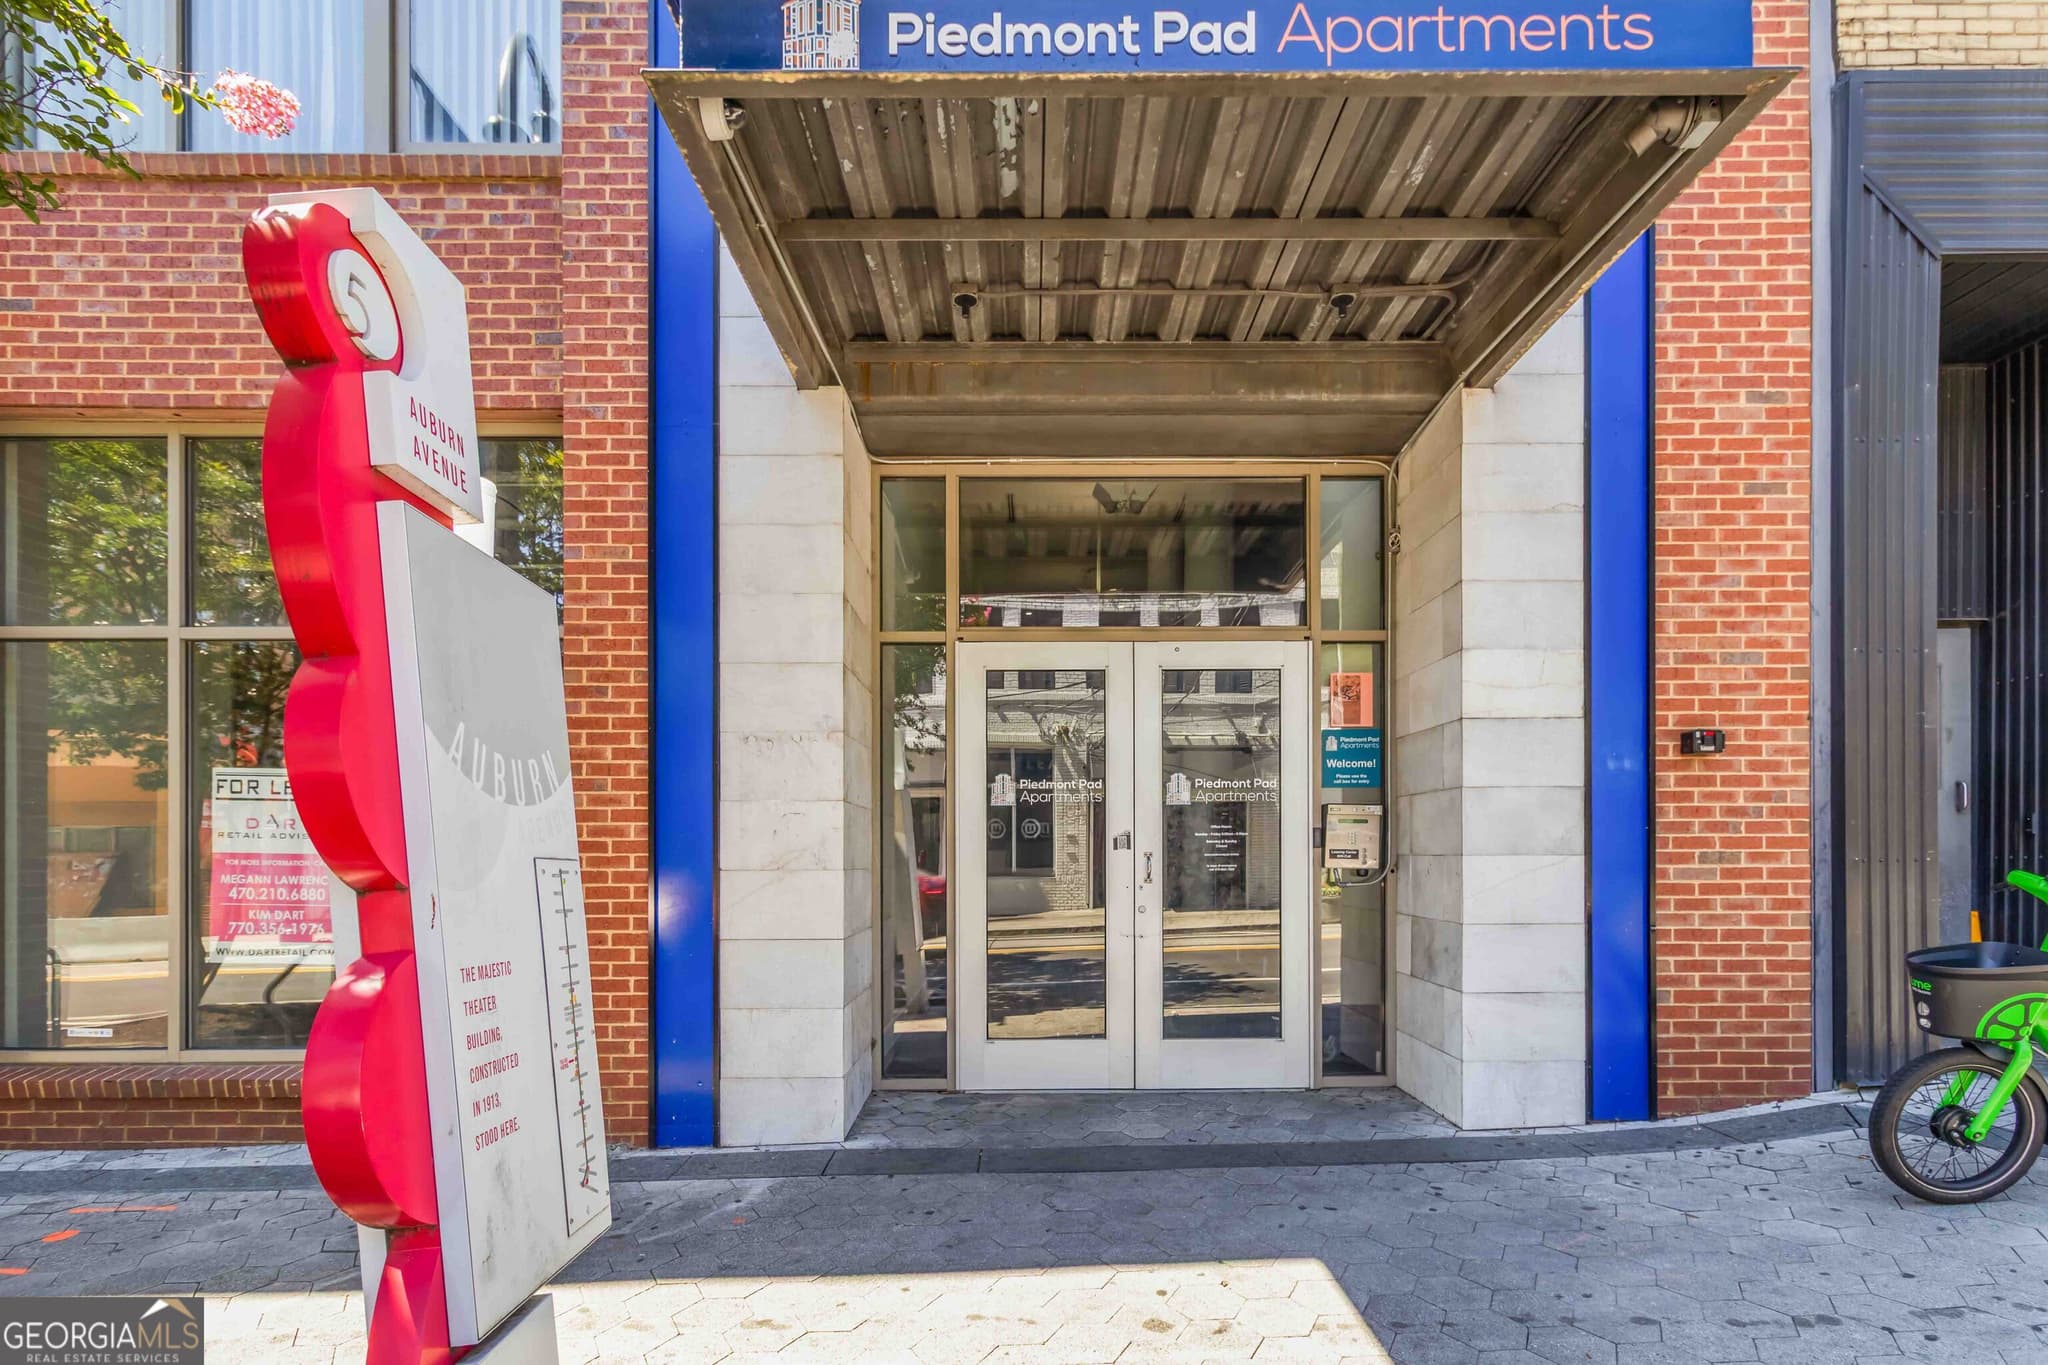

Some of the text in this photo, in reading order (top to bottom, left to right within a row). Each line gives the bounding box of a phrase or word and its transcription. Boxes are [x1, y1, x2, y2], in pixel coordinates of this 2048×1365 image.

[888, 2, 1654, 67] Piedmont Pad Apartments
[410, 396, 465, 458] AUBURN
[413, 435, 468, 494] AVENUE
[1340, 742, 1379, 750] Apartments
[448, 721, 560, 806] AUBURN
[1326, 759, 1376, 768] Welcome!
[216, 779, 259, 795] FOR
[1020, 779, 1102, 789] Piedmont Pad
[1195, 778, 1277, 788] Piedmont Pad
[1020, 790, 1103, 805] Apartments
[1195, 789, 1277, 804] Apartments
[217, 832, 263, 840] RETAIL
[220, 874, 329, 885] MEGANN LAWRENC
[228, 887, 326, 901] 470.210.6880
[248, 910, 305, 921] KIM DART
[460, 960, 512, 984] THE MAJESTIC
[463, 995, 497, 1017] THEATER
[469, 1052, 519, 1084] CONSTRUCTED
[472, 1100, 481, 1117] IN
[475, 1129, 499, 1151] STOOD
